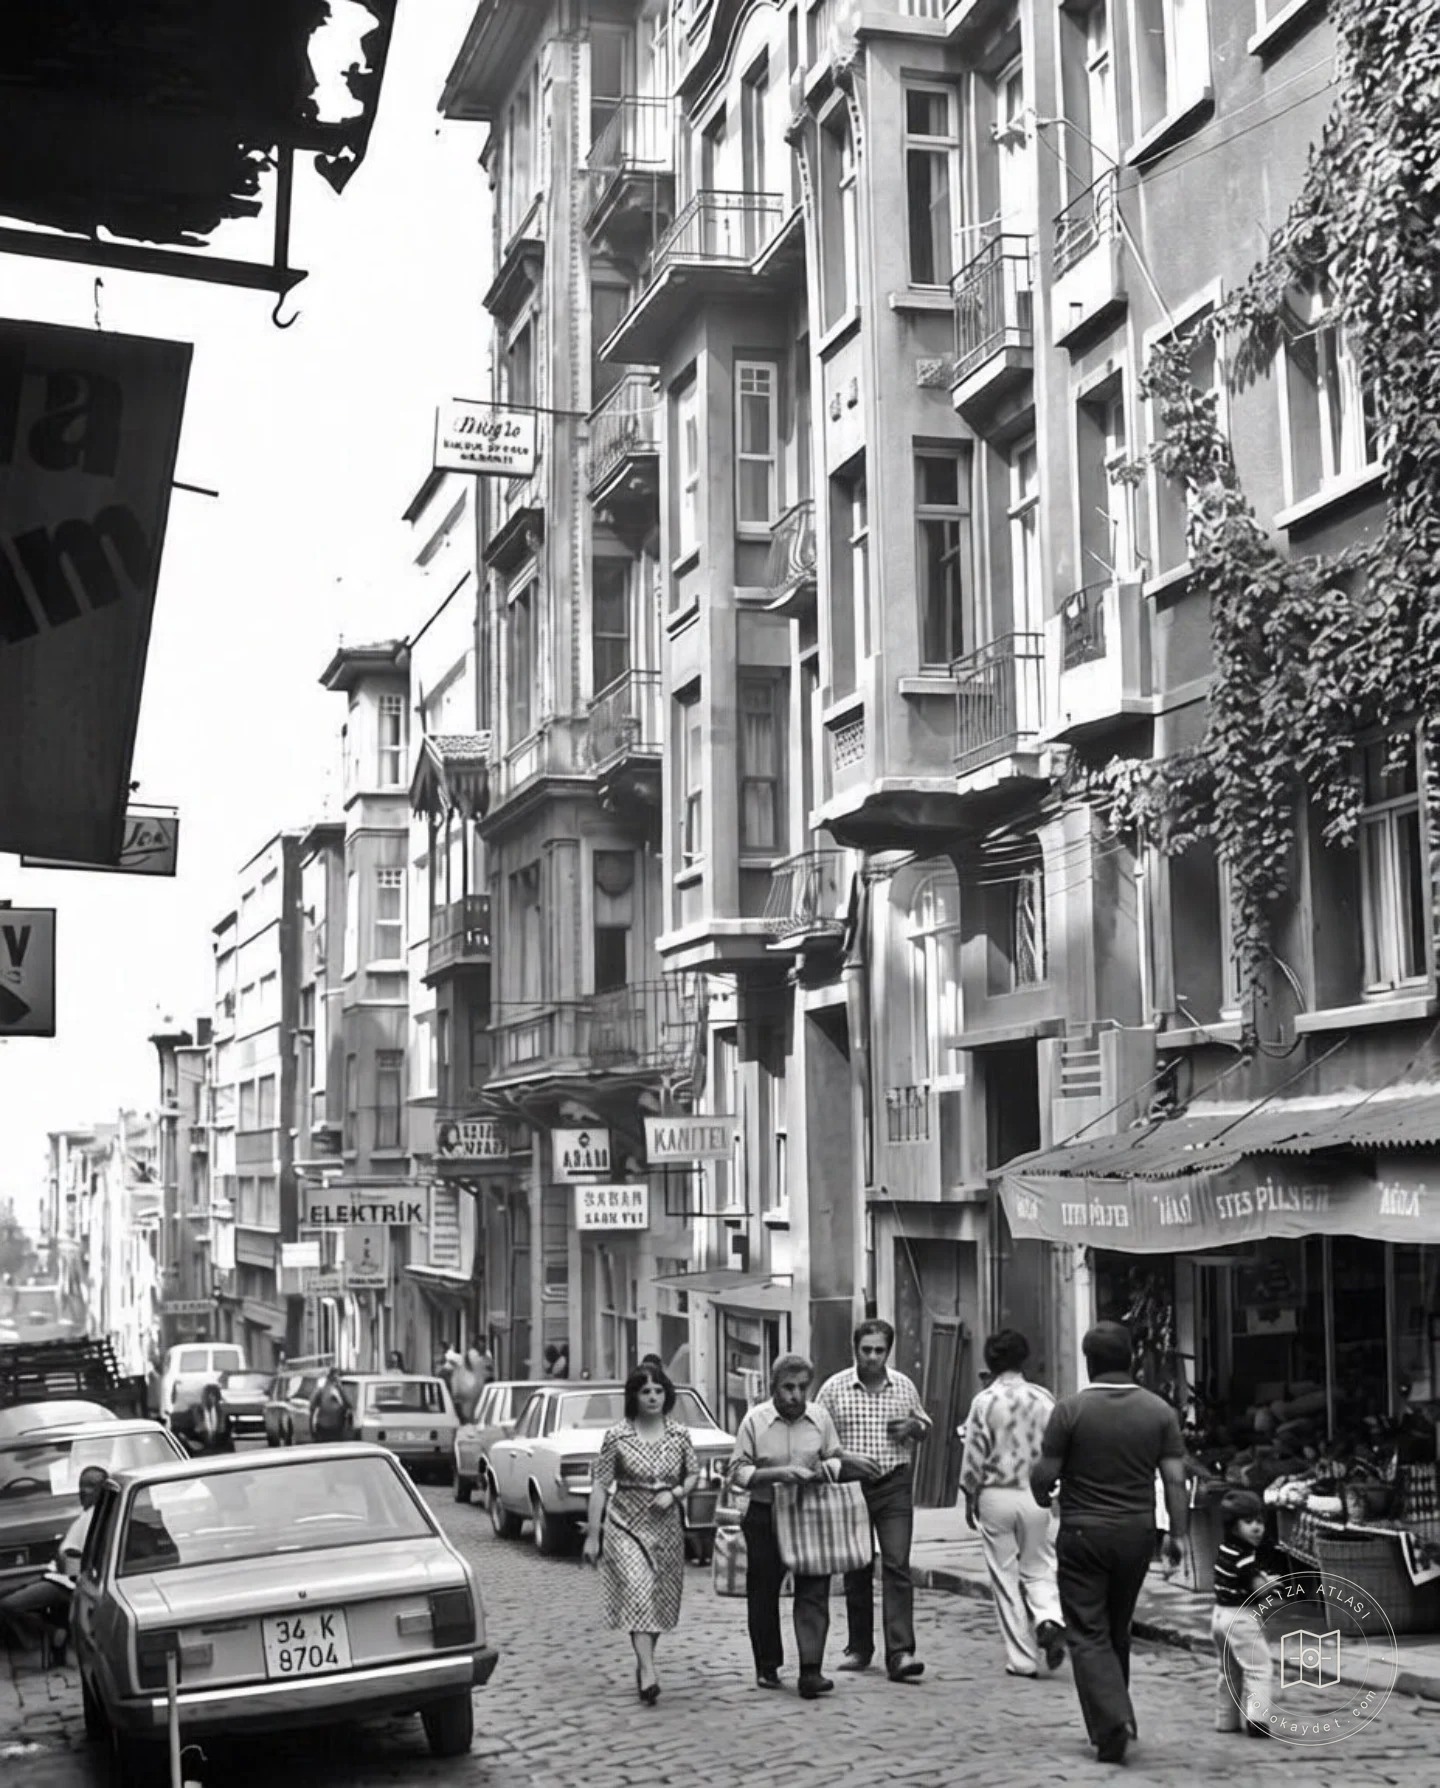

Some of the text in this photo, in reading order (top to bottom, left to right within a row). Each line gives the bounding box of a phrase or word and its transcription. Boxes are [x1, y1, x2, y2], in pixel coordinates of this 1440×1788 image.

[311, 1201, 423, 1223] ELEKTRİK
[276, 1618, 306, 1644] 34
[320, 1613, 335, 1640] K
[279, 1641, 339, 1673] 8704
